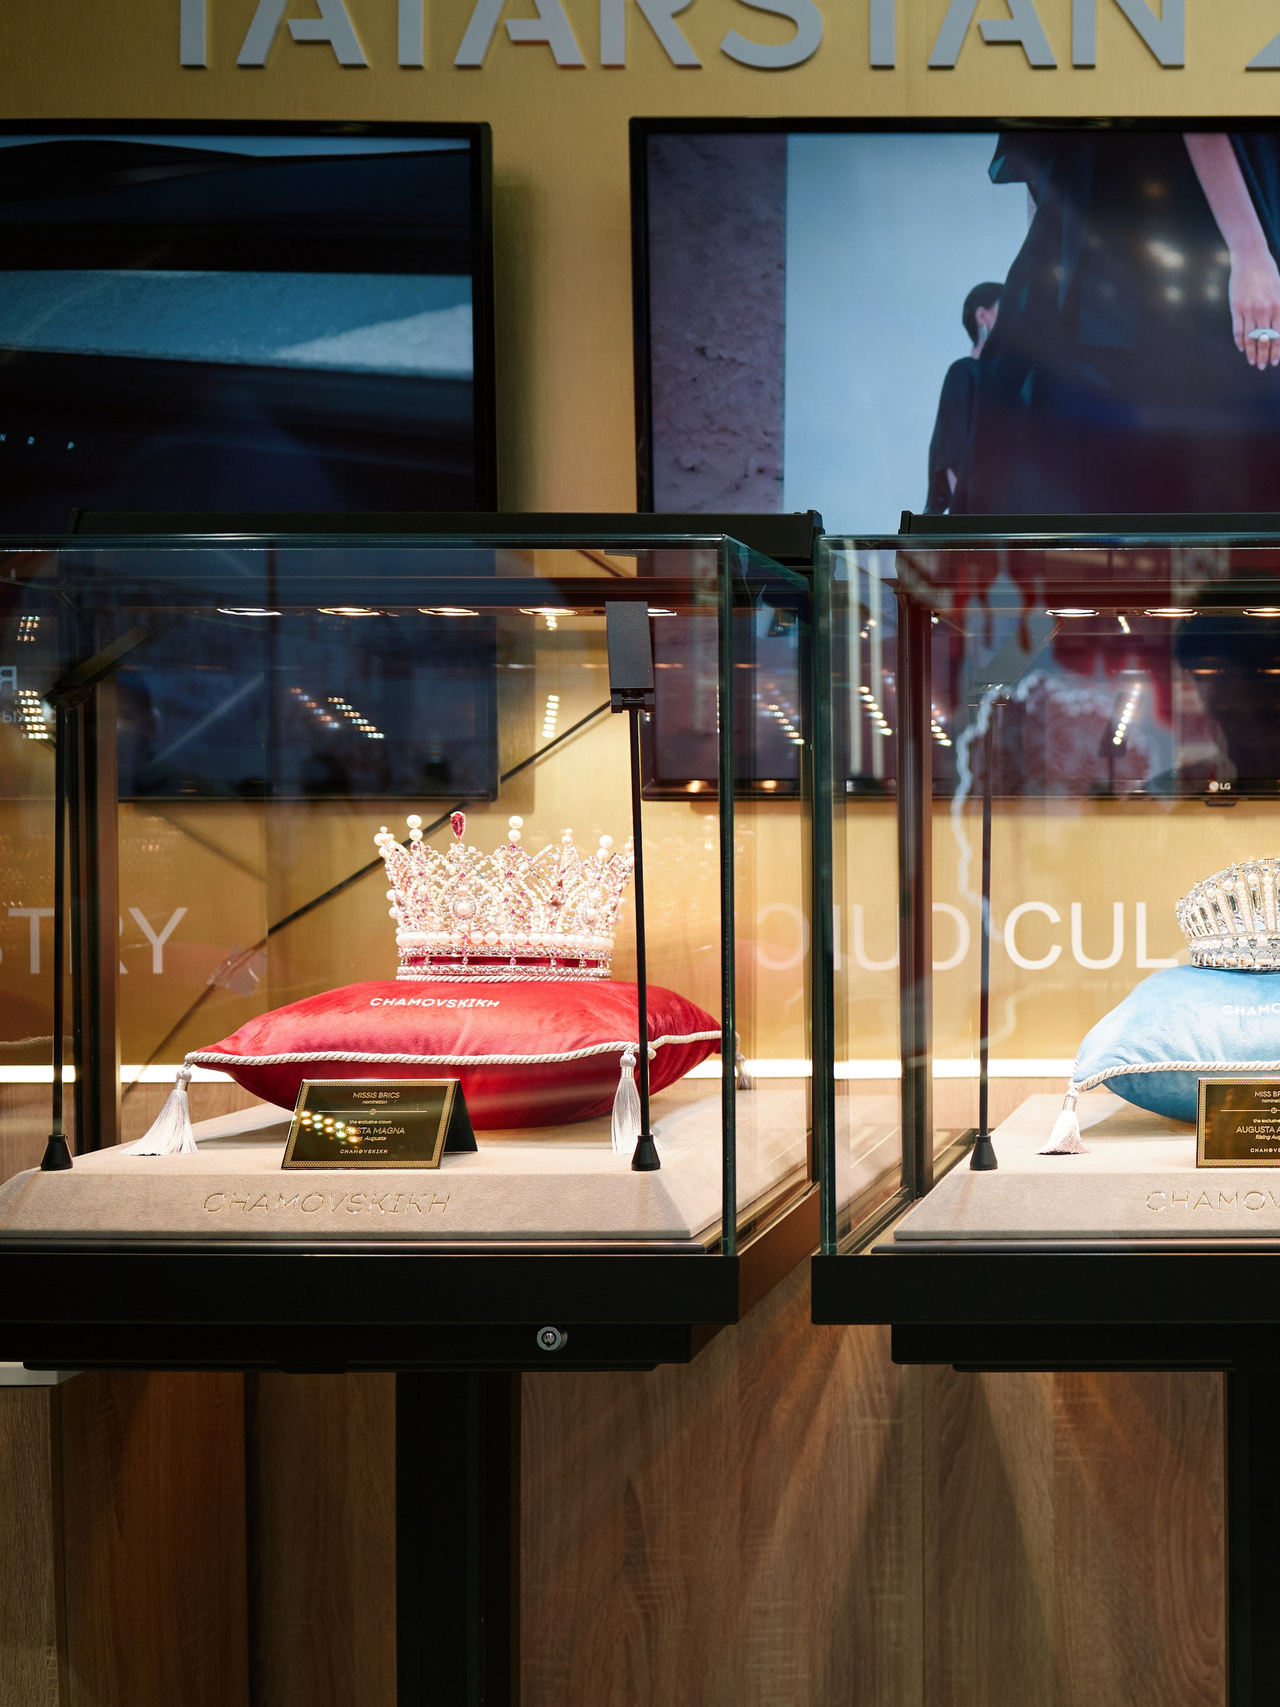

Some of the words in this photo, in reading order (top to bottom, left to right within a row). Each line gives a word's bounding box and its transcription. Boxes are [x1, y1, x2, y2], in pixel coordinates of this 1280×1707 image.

[369, 998, 500, 1008] CHAMOVSKIKH
[352, 1091, 377, 1099] MISSIS
[378, 1091, 400, 1099] BRICS
[1254, 1090, 1271, 1098] MISS
[373, 1126, 405, 1135] MAGNA
[1236, 1125, 1275, 1134] AUGUSTA
[202, 1192, 452, 1214] CHAMOVSKIKH
